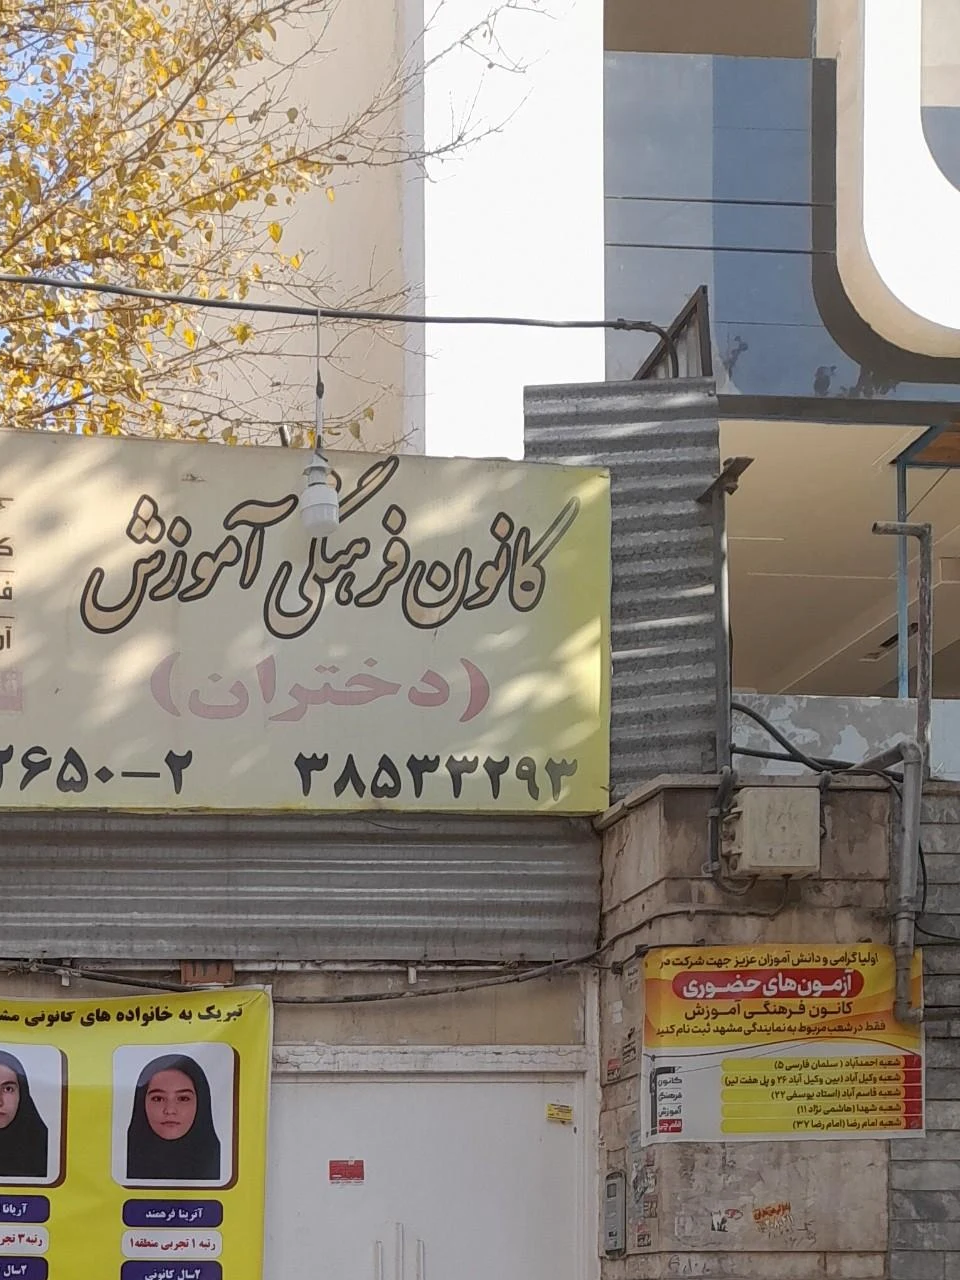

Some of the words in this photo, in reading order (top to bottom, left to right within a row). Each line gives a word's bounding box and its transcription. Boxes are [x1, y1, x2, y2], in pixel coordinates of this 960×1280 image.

[81, 494, 299, 634] آموزش
[403, 497, 580, 629] کانون
[150, 652, 490, 722] (دختران)
[294, 751, 578, 801] ۳۸۵۳۳۲۹۳
[660, 958, 670, 969] در
[672, 956, 705, 969] شرکت
[706, 957, 732, 968] جهت
[734, 956, 757, 968] عزیز
[758, 950, 791, 967] آموزان
[792, 952, 821, 966] دانش
[830, 952, 858, 966] گرامی
[859, 952, 879, 966] اولیا
[683, 974, 762, 999] حضوری
[116, 1006, 173, 1026] خانواده
[179, 1007, 193, 1024] به
[198, 1003, 243, 1022] تبریک
[684, 1000, 742, 1020] آموزش
[744, 1000, 806, 1019] فرهنگی
[809, 1002, 853, 1019] کانون
[25, 1010, 75, 1027] کانونی
[80, 1008, 111, 1027] های
[656, 1025, 675, 1037] کنید
[676, 1024, 690, 1036] نام
[692, 1023, 711, 1036] ثبت
[712, 1023, 743, 1036] مشهد
[744, 1022, 787, 1036] نمایندگی
[787, 1026, 797, 1035] به
[798, 1022, 827, 1035] مربوط
[828, 1023, 854, 1035] شعب
[865, 1021, 886, 1031] فقط
[786, 1059, 810, 1071] فارسی
[879, 1058, 901, 1069] شعبه
[789, 1073, 802, 1086] آباد
[804, 1074, 824, 1085] وکیل
[845, 1072, 858, 1084] آباد
[859, 1074, 877, 1084] وکیل
[879, 1073, 902, 1084] شعبه
[786, 1090, 815, 1101] یوسفی
[842, 1087, 855, 1099] آباد
[856, 1087, 877, 1099] قاسم
[879, 1088, 902, 1099] شعبه
[808, 1105, 822, 1115] نژاد
[857, 1104, 877, 1114] شهدا
[879, 1104, 902, 1114] شعبه
[811, 1119, 825, 1130] رضا
[846, 1119, 861, 1129] رضا
[862, 1119, 878, 1129] امام
[880, 1118, 902, 1129] شعبه
[2, 1203, 28, 1216] آریانا
[161, 1238, 189, 1251] تجربی
[199, 1238, 216, 1251] رتبه
